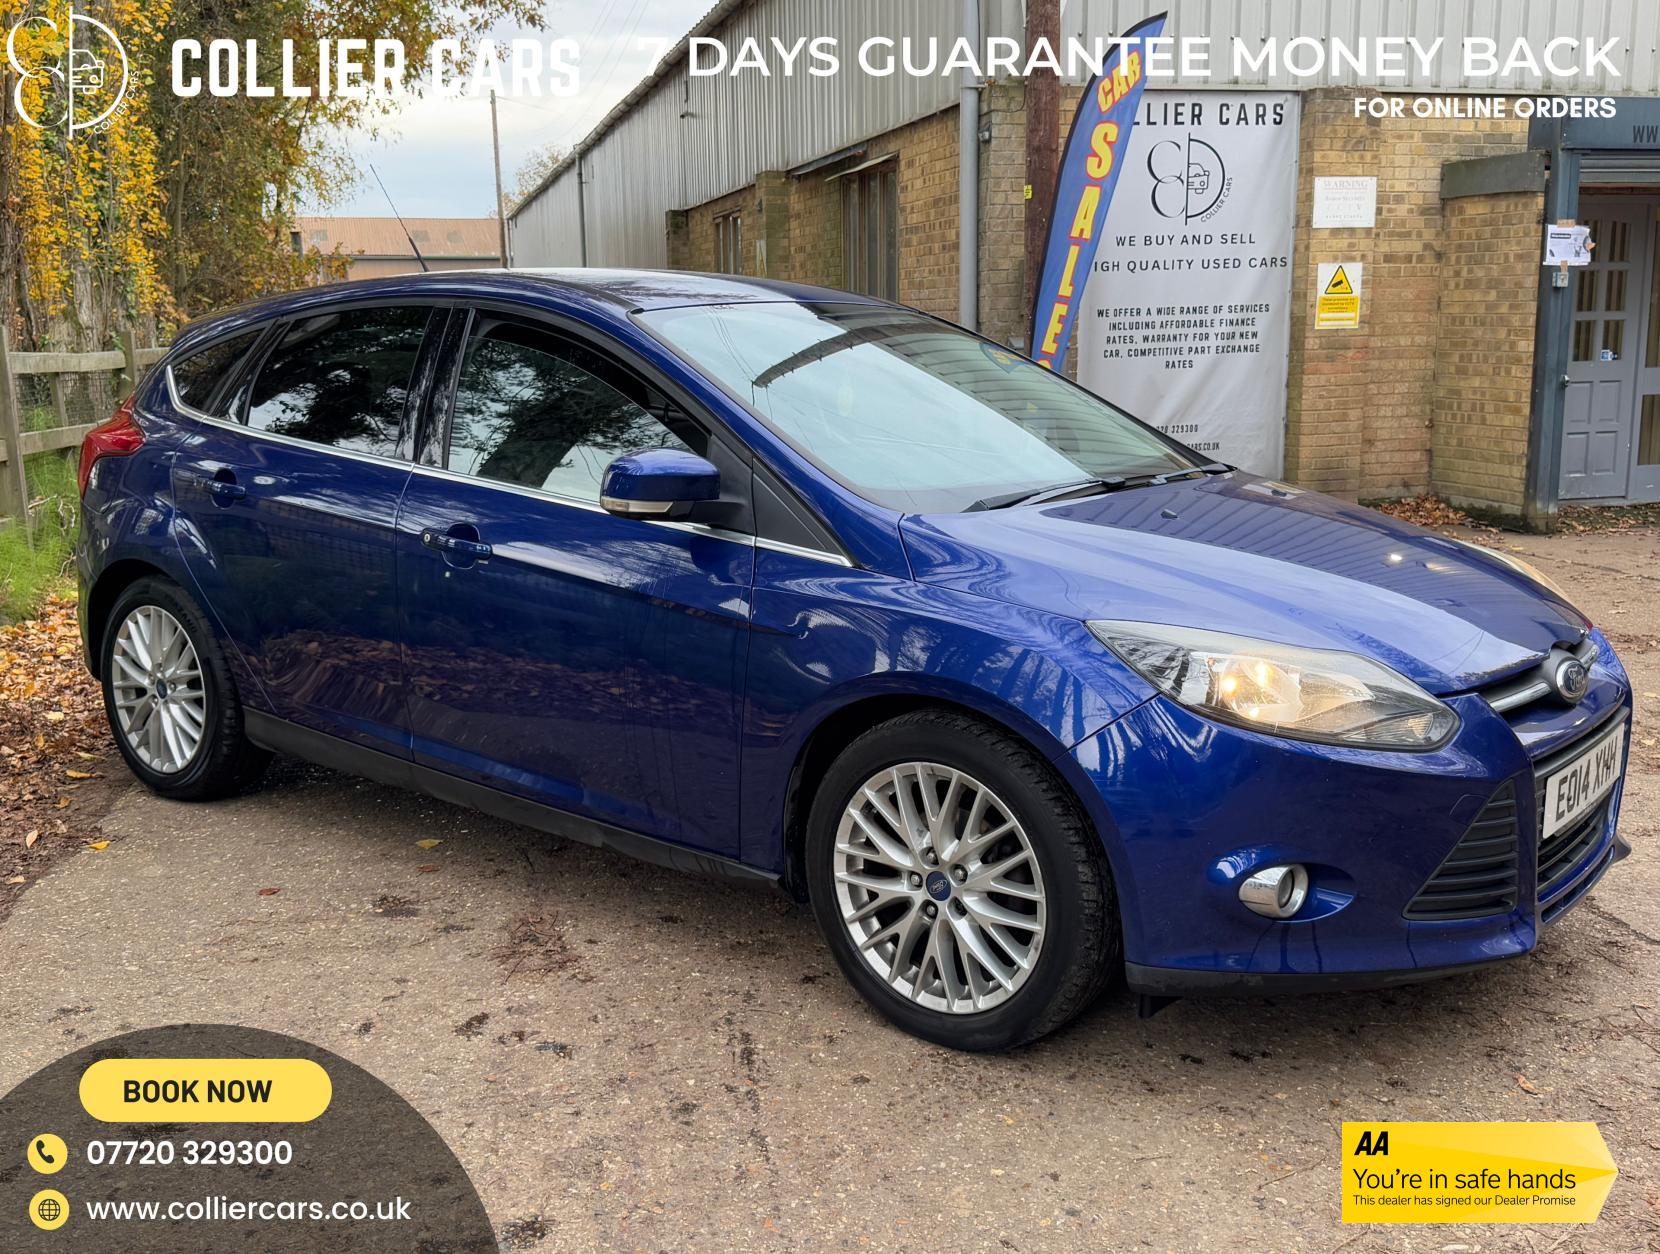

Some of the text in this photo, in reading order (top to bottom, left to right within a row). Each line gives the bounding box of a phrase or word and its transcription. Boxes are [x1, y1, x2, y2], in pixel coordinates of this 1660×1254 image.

[1097, 49, 1142, 113] CAR
[1133, 102, 1284, 126] LIER CARS
[1200, 177, 1233, 222] COLLIER CARS
[1035, 121, 1119, 369] SALE
[1116, 233, 1256, 247] WE BUY AND SELL
[1094, 256, 1288, 274] IGH QUALITY USED CARS
[1097, 303, 1270, 318] WE OFFER A WIDE RANGE OF SERVICES
[1108, 317, 1256, 331] INCLUDING AFFORDABLE FINANCE
[1142, 333, 1189, 343] WARRANTY
[1193, 332, 1210, 342] FOR
[1214, 331, 1236, 341] YOUR
[1240, 330, 1258, 340] NEW
[1127, 346, 1184, 357] COMPETITIVE
[1188, 345, 1211, 355] PART
[1216, 343, 1260, 354] EXCHANGE
[1165, 359, 1193, 369] RATES
[1172, 424, 1199, 434] 329300
[1592, 735, 1618, 794] XHH
